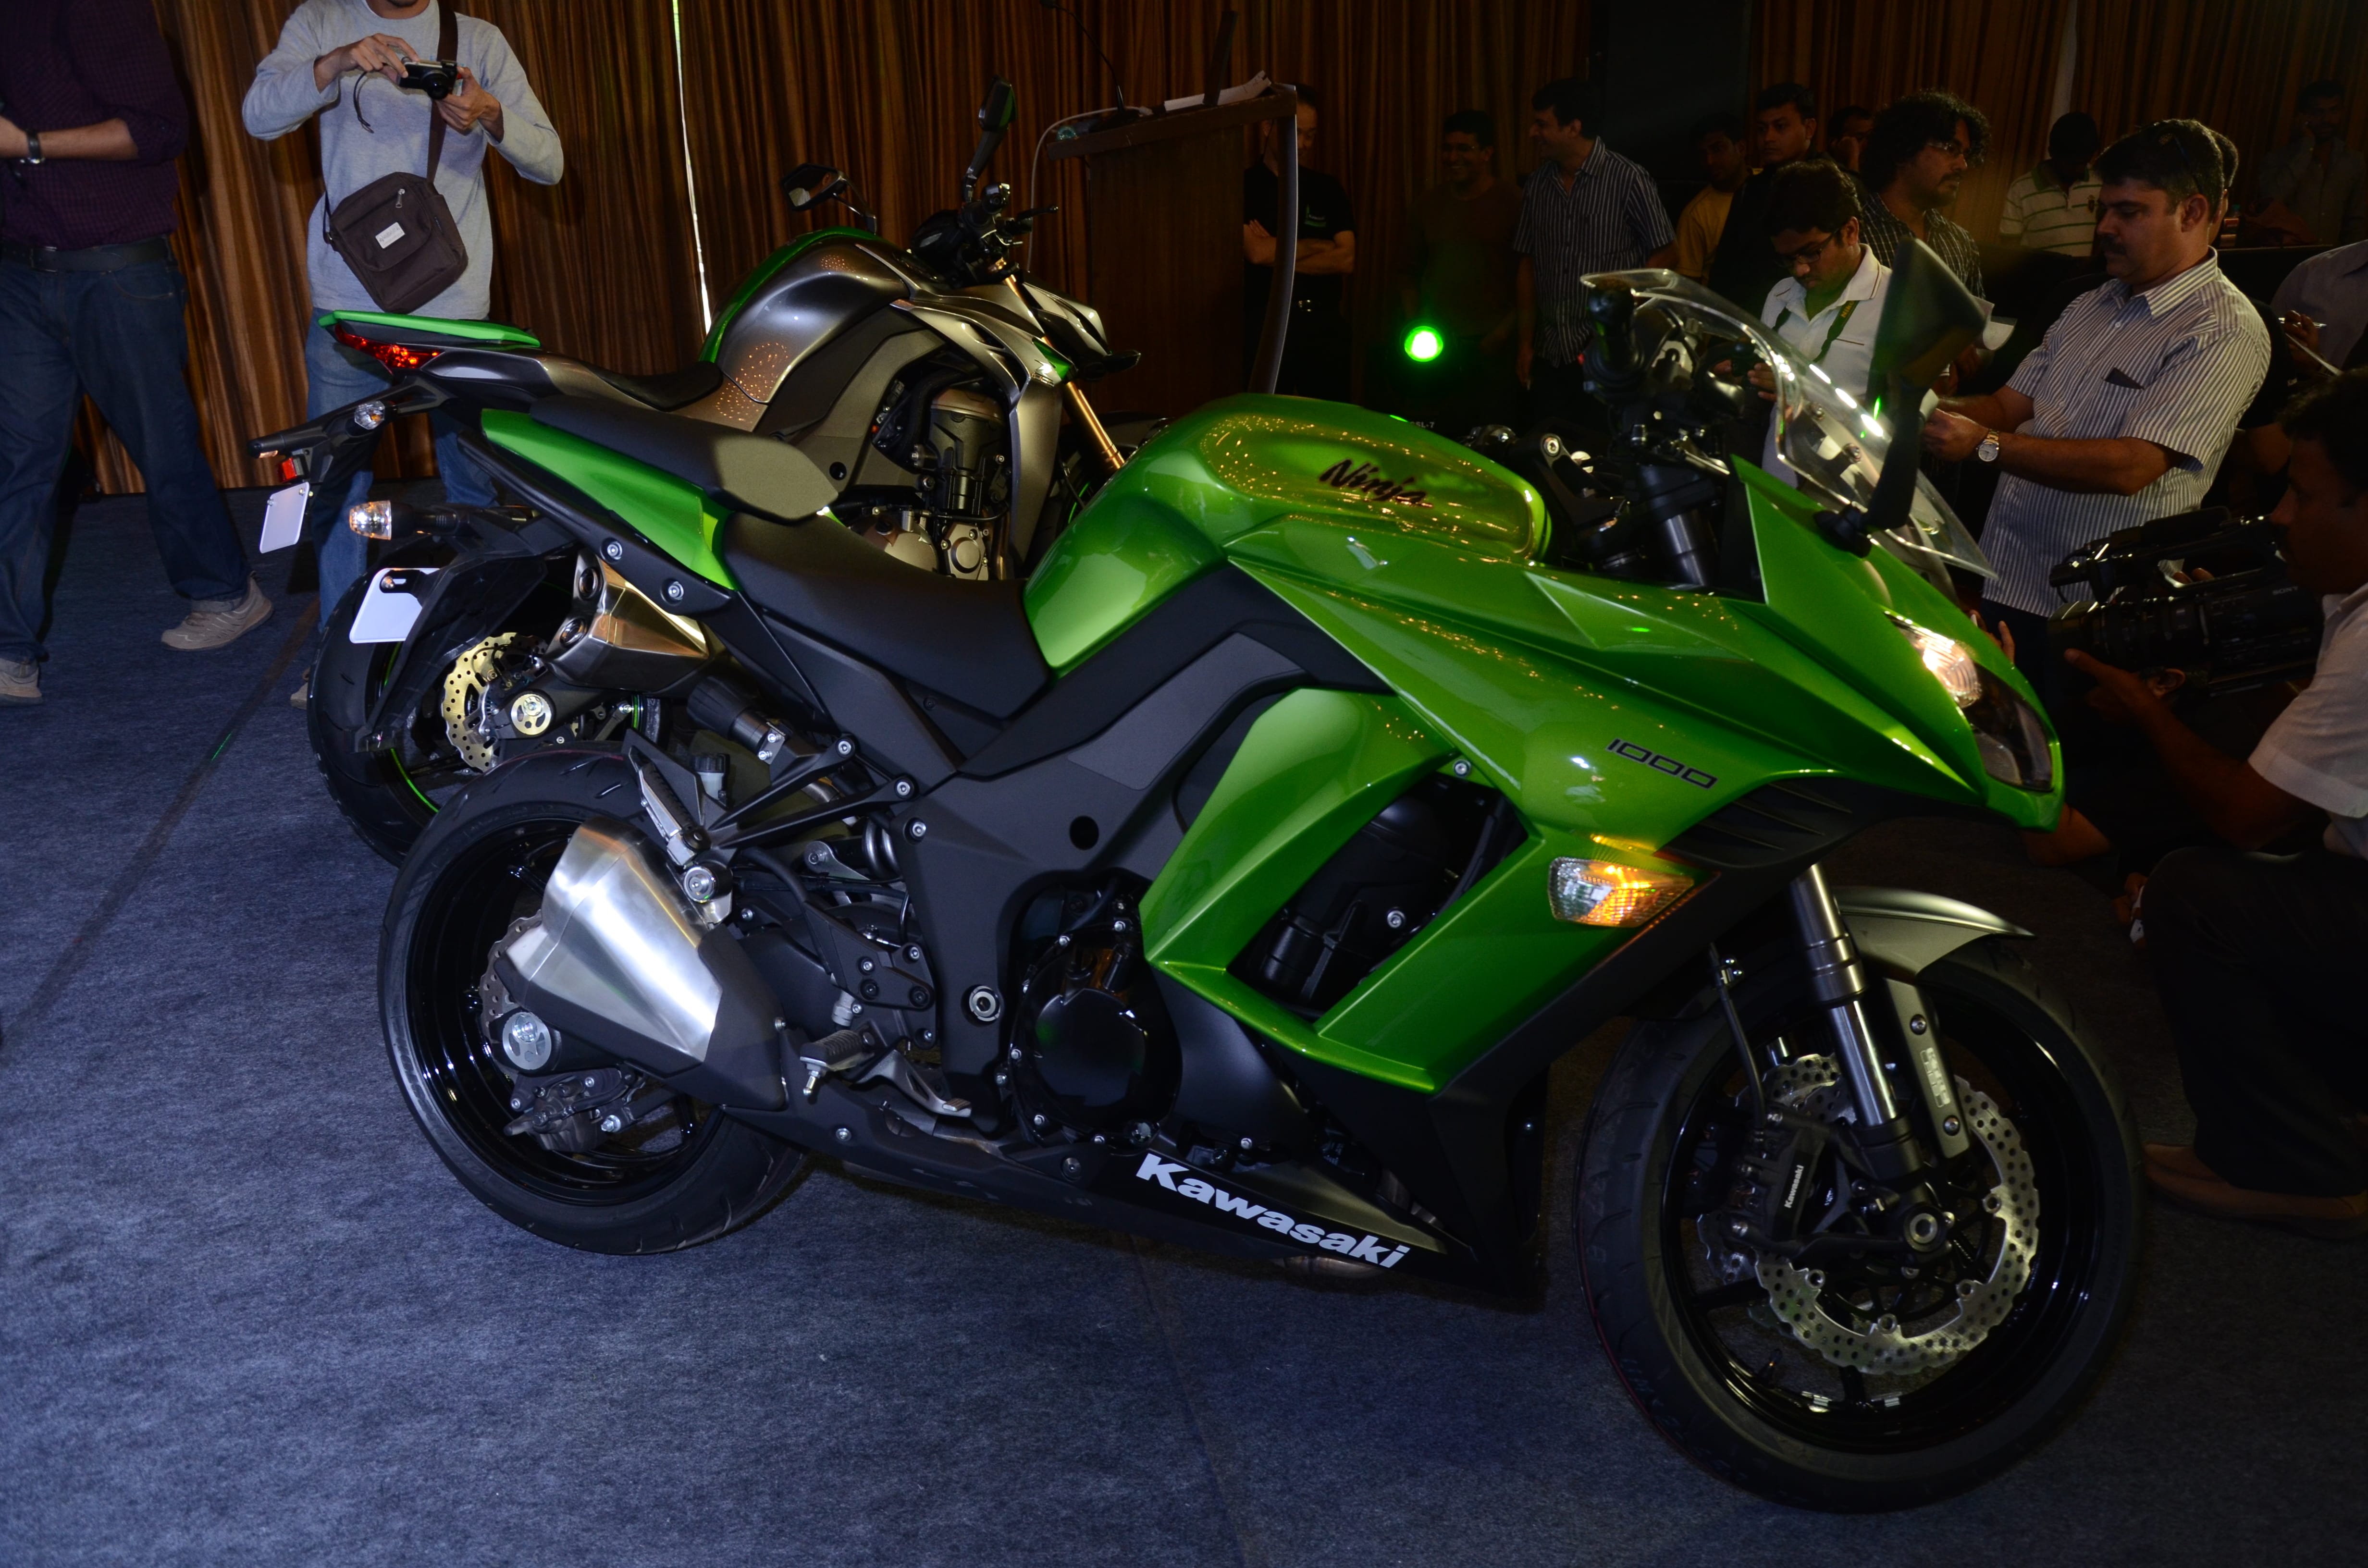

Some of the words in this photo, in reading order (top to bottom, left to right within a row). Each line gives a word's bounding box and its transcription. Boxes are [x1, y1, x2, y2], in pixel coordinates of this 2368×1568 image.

[1840, 301, 1854, 318] NIKO
[1319, 458, 1433, 507] Ninja
[2272, 586, 2299, 596] SONY
[1605, 737, 1719, 790] 1000
[1784, 1164, 1804, 1209] Kawasaki
[1135, 1152, 1411, 1269] Kawasaki
